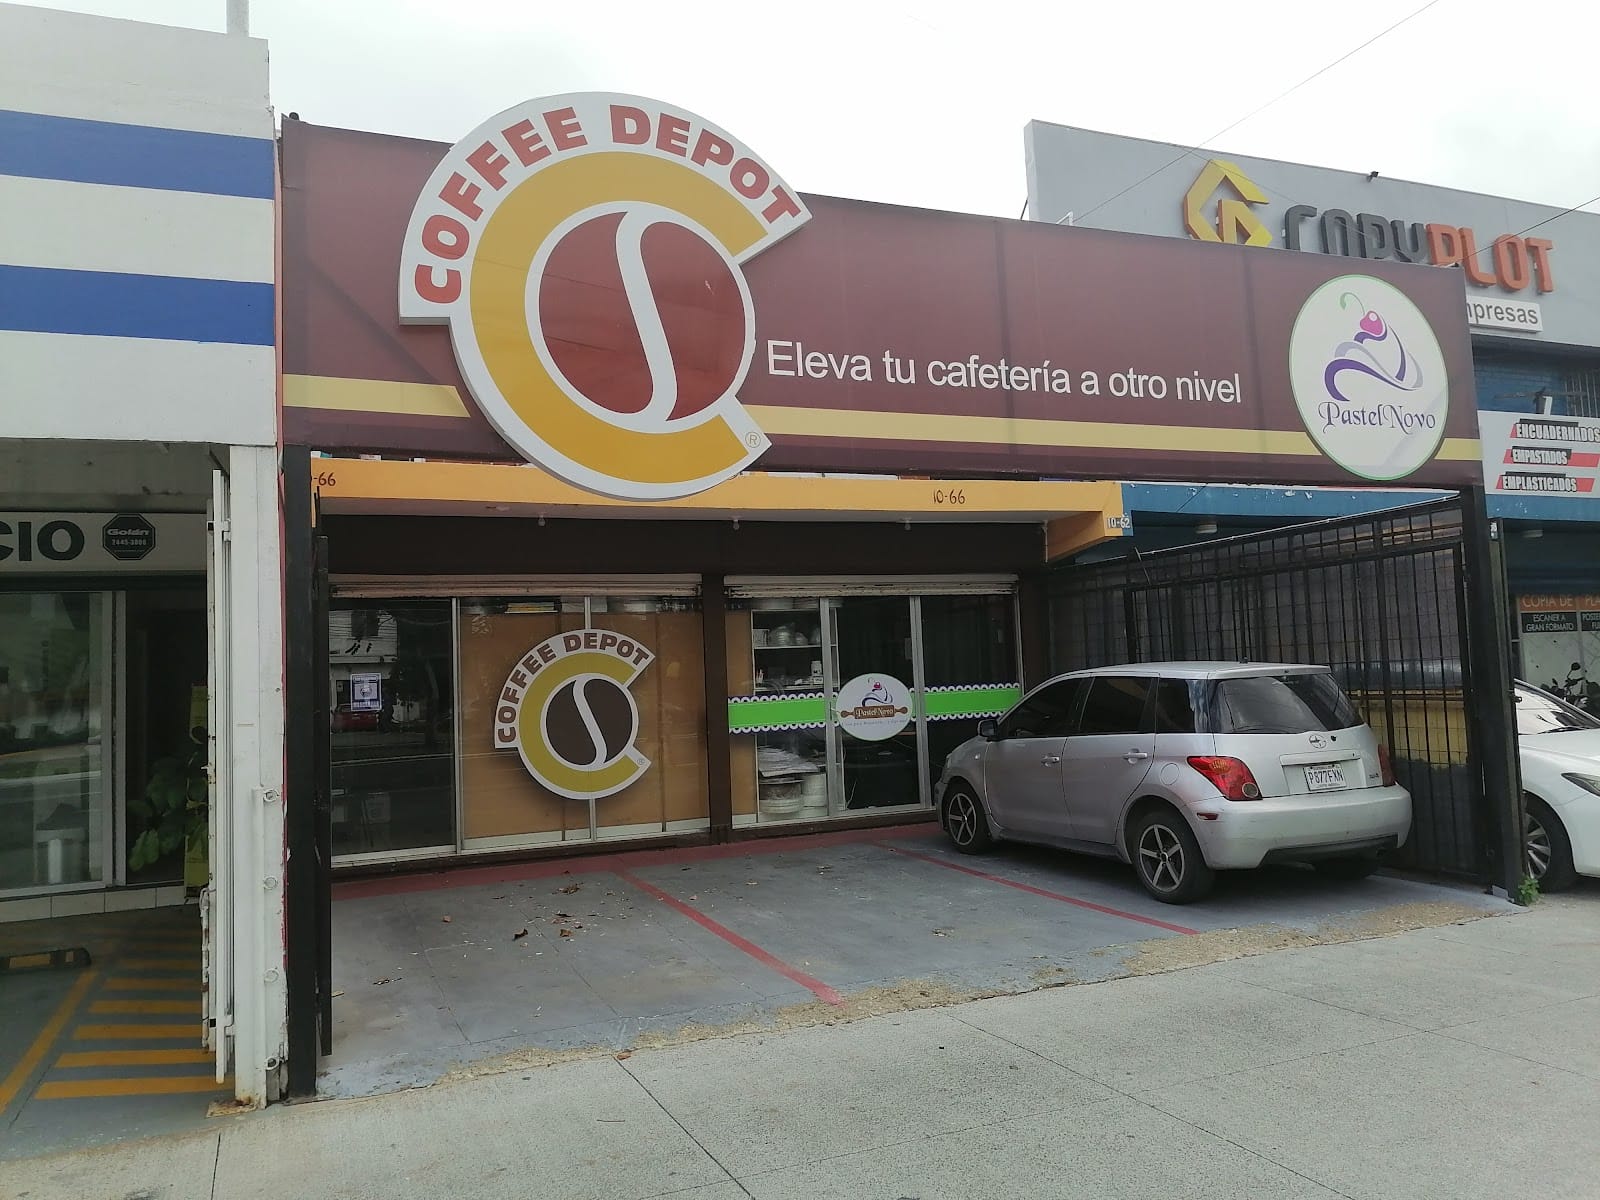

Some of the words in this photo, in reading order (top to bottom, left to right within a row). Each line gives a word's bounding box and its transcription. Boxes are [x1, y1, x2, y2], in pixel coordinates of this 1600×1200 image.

[414, 106, 588, 304] COFFEE
[609, 104, 801, 225] DEPOT
[767, 339, 872, 382] Eleva
[883, 350, 915, 385] tu
[927, 354, 1071, 394] cafetería
[1080, 371, 1100, 396] a
[1108, 367, 1168, 399] otro
[1176, 370, 1242, 404] nivel
[1515, 422, 1600, 443] ENCUADERNADOS
[1512, 448, 1568, 466] EMPASTADOS
[311, 471, 337, 487] -66
[1502, 475, 1577, 493] EMPLASTICADOS
[933, 488, 966, 505] 10-66
[1522, 594, 1557, 608] COPIA
[1559, 593, 1574, 607] DE
[1526, 623, 1545, 632] GRAN
[1545, 622, 1574, 631] FORMATO
[1533, 614, 1559, 623] ESCANER
[1560, 614, 1566, 622] A
[497, 643, 557, 743] COFFEE
[563, 632, 649, 666] DEPOT
